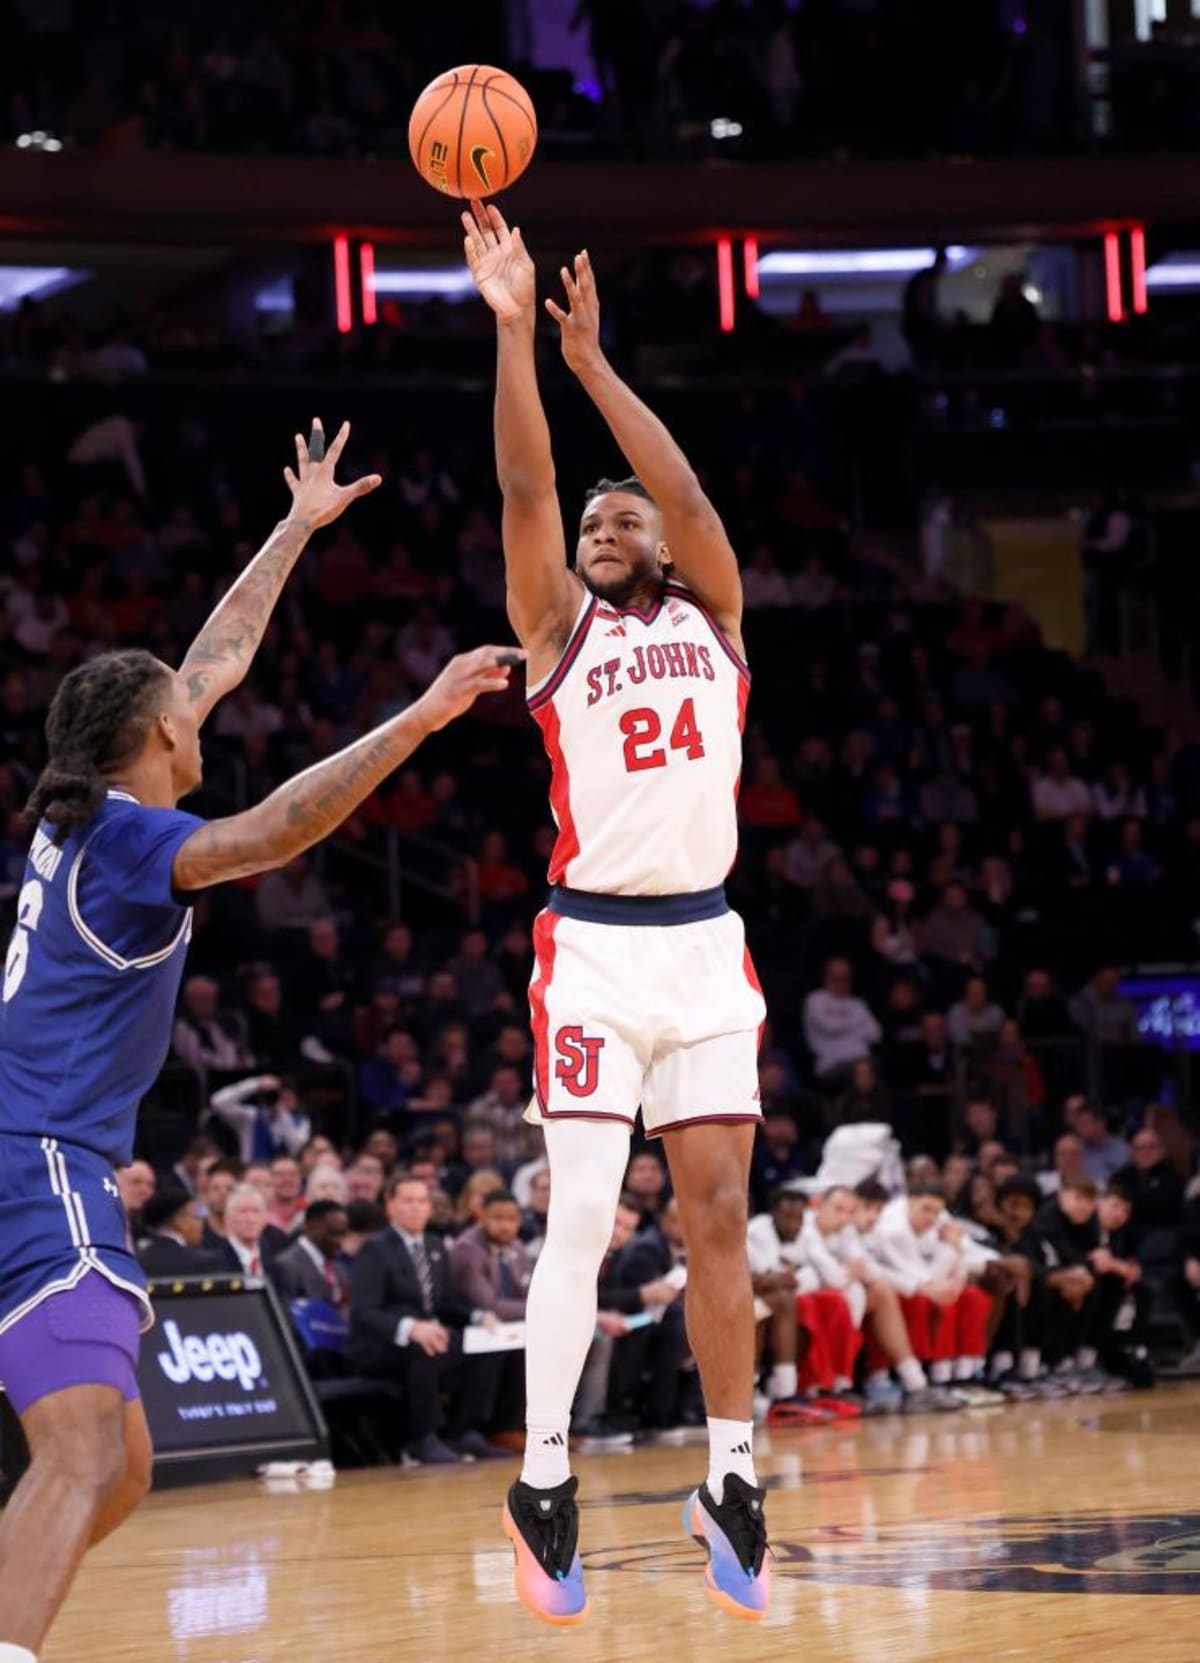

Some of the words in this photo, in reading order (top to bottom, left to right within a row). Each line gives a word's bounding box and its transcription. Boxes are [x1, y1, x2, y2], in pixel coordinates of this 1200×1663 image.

[431, 140, 449, 191] ELI
[586, 657, 622, 708] ST.
[618, 697, 706, 773] 24
[3, 879, 43, 1003] 6
[555, 1025, 606, 1098] SJ
[157, 1319, 262, 1391] Jeep
